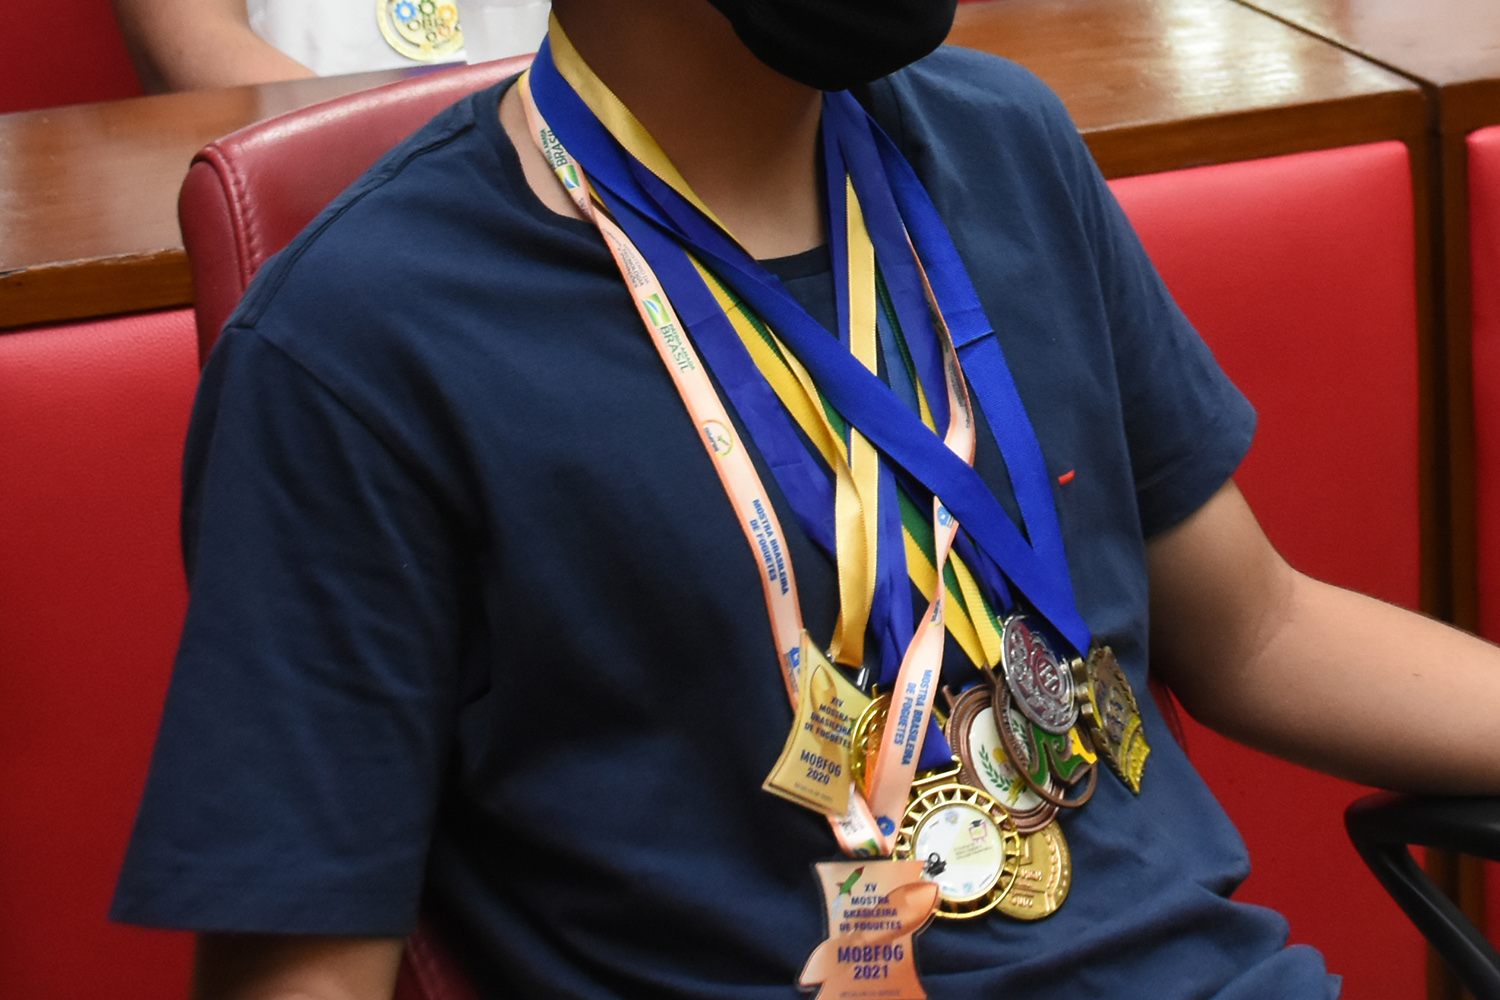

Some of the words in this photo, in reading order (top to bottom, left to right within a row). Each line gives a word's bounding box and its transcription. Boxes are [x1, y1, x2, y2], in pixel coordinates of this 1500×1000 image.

[660, 325, 690, 374] BRASIL
[749, 519, 761, 532] DE
[756, 533, 778, 582] FOGUETES
[752, 498, 774, 538] MOSTRA
[769, 538, 790, 596] BRASILEIRA
[905, 682, 917, 694] DE
[915, 669, 933, 707] MOSTRA
[819, 704, 850, 723] MOSTRA
[893, 696, 914, 747] FOGUETES
[804, 722, 814, 733] DE
[810, 713, 852, 736] BRASILEIRA
[901, 709, 923, 766] BRASILEIRA
[799, 749, 842, 778] MOBFOG
[806, 767, 831, 786] 2020
[864, 882, 877, 893] XV
[851, 896, 890, 906] MOSTRA
[843, 908, 898, 919] BRASILEIRA
[839, 923, 852, 932] DE
[854, 921, 903, 932] FOGUETES
[837, 944, 905, 964] MOBFOG
[853, 964, 889, 980] 2021
